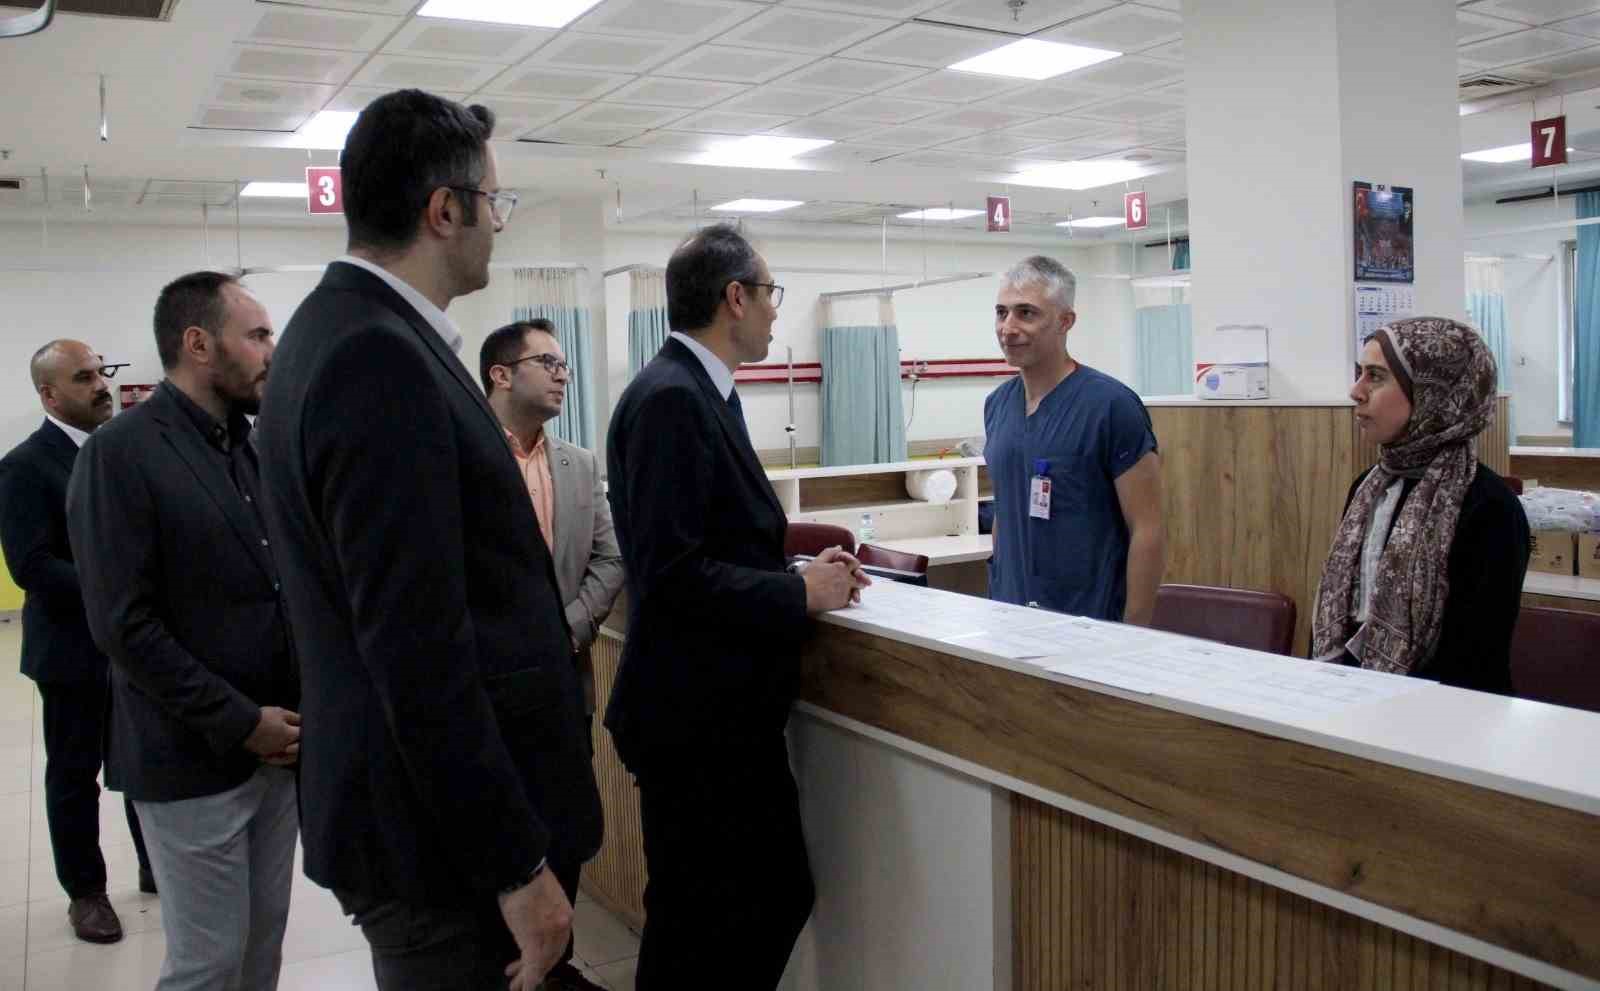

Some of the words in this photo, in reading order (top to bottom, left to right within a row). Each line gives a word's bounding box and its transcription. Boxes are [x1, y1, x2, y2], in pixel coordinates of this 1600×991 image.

[1541, 126, 1556, 158] 7
[318, 175, 336, 206] 3
[994, 203, 1005, 226] 4
[1131, 198, 1142, 223] 6
